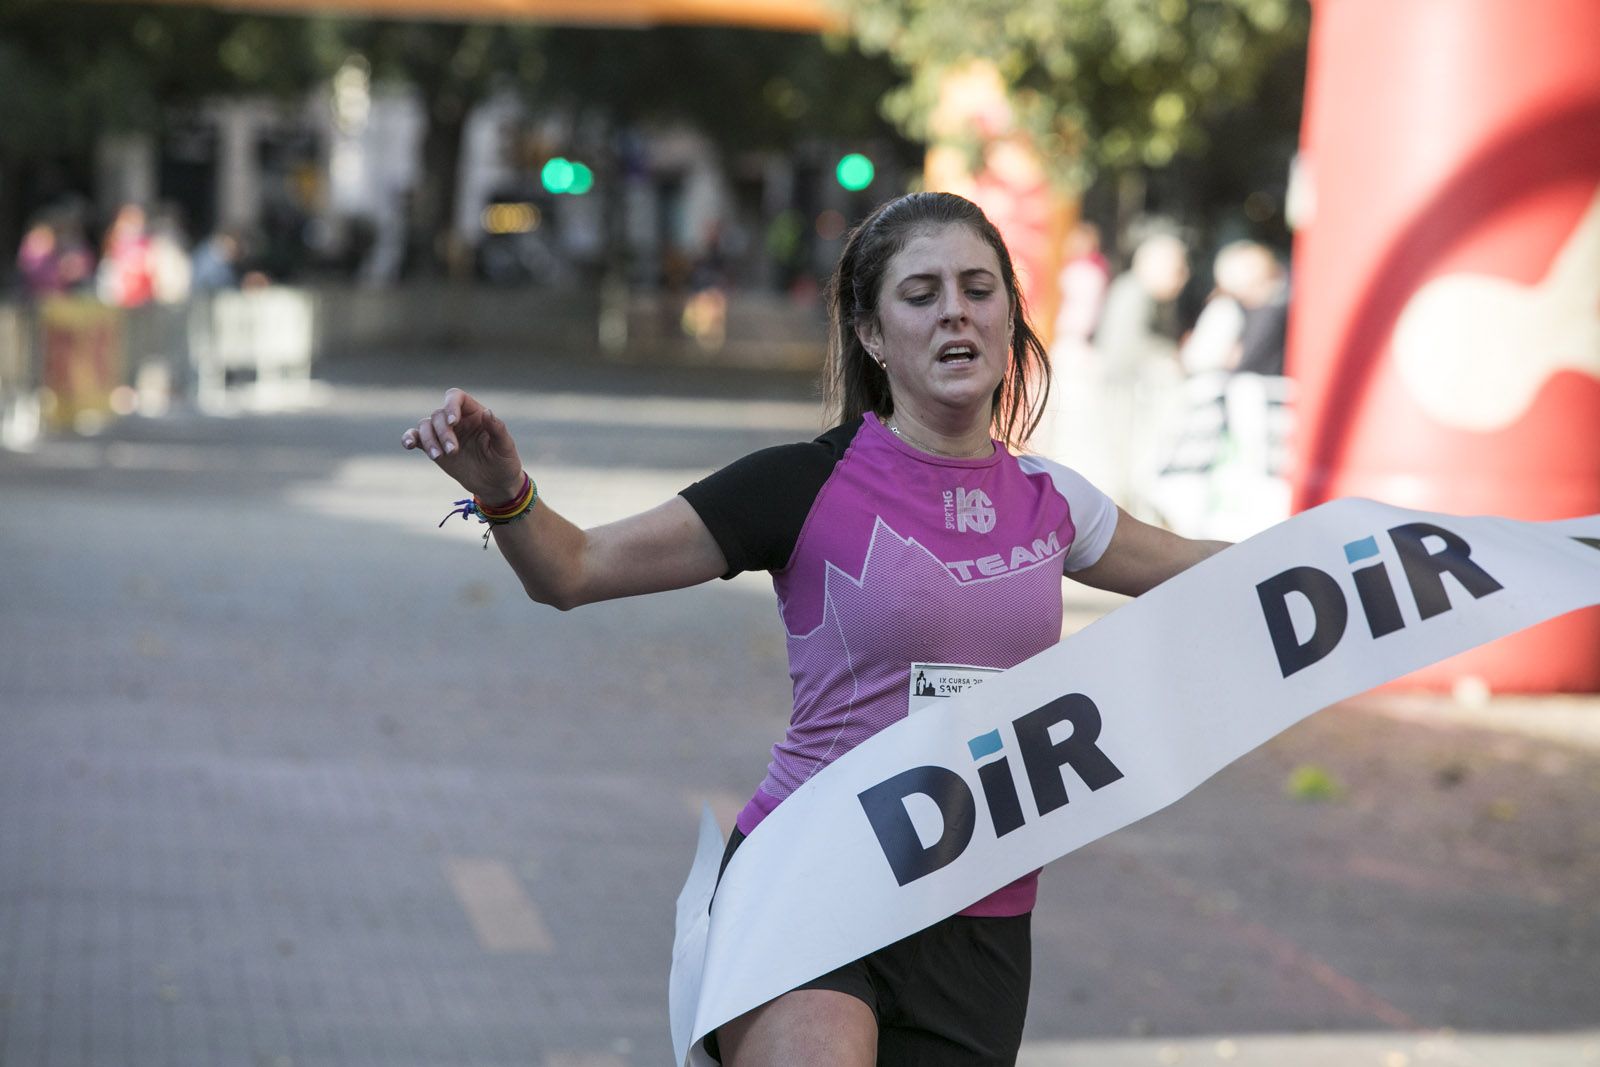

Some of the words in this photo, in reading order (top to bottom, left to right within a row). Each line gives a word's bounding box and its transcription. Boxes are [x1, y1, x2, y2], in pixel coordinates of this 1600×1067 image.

[943, 490, 955, 530] SPORTHG
[945, 531, 1061, 581] TEAM
[939, 684, 963, 693] SANT
[948, 677, 971, 685] CURSA
